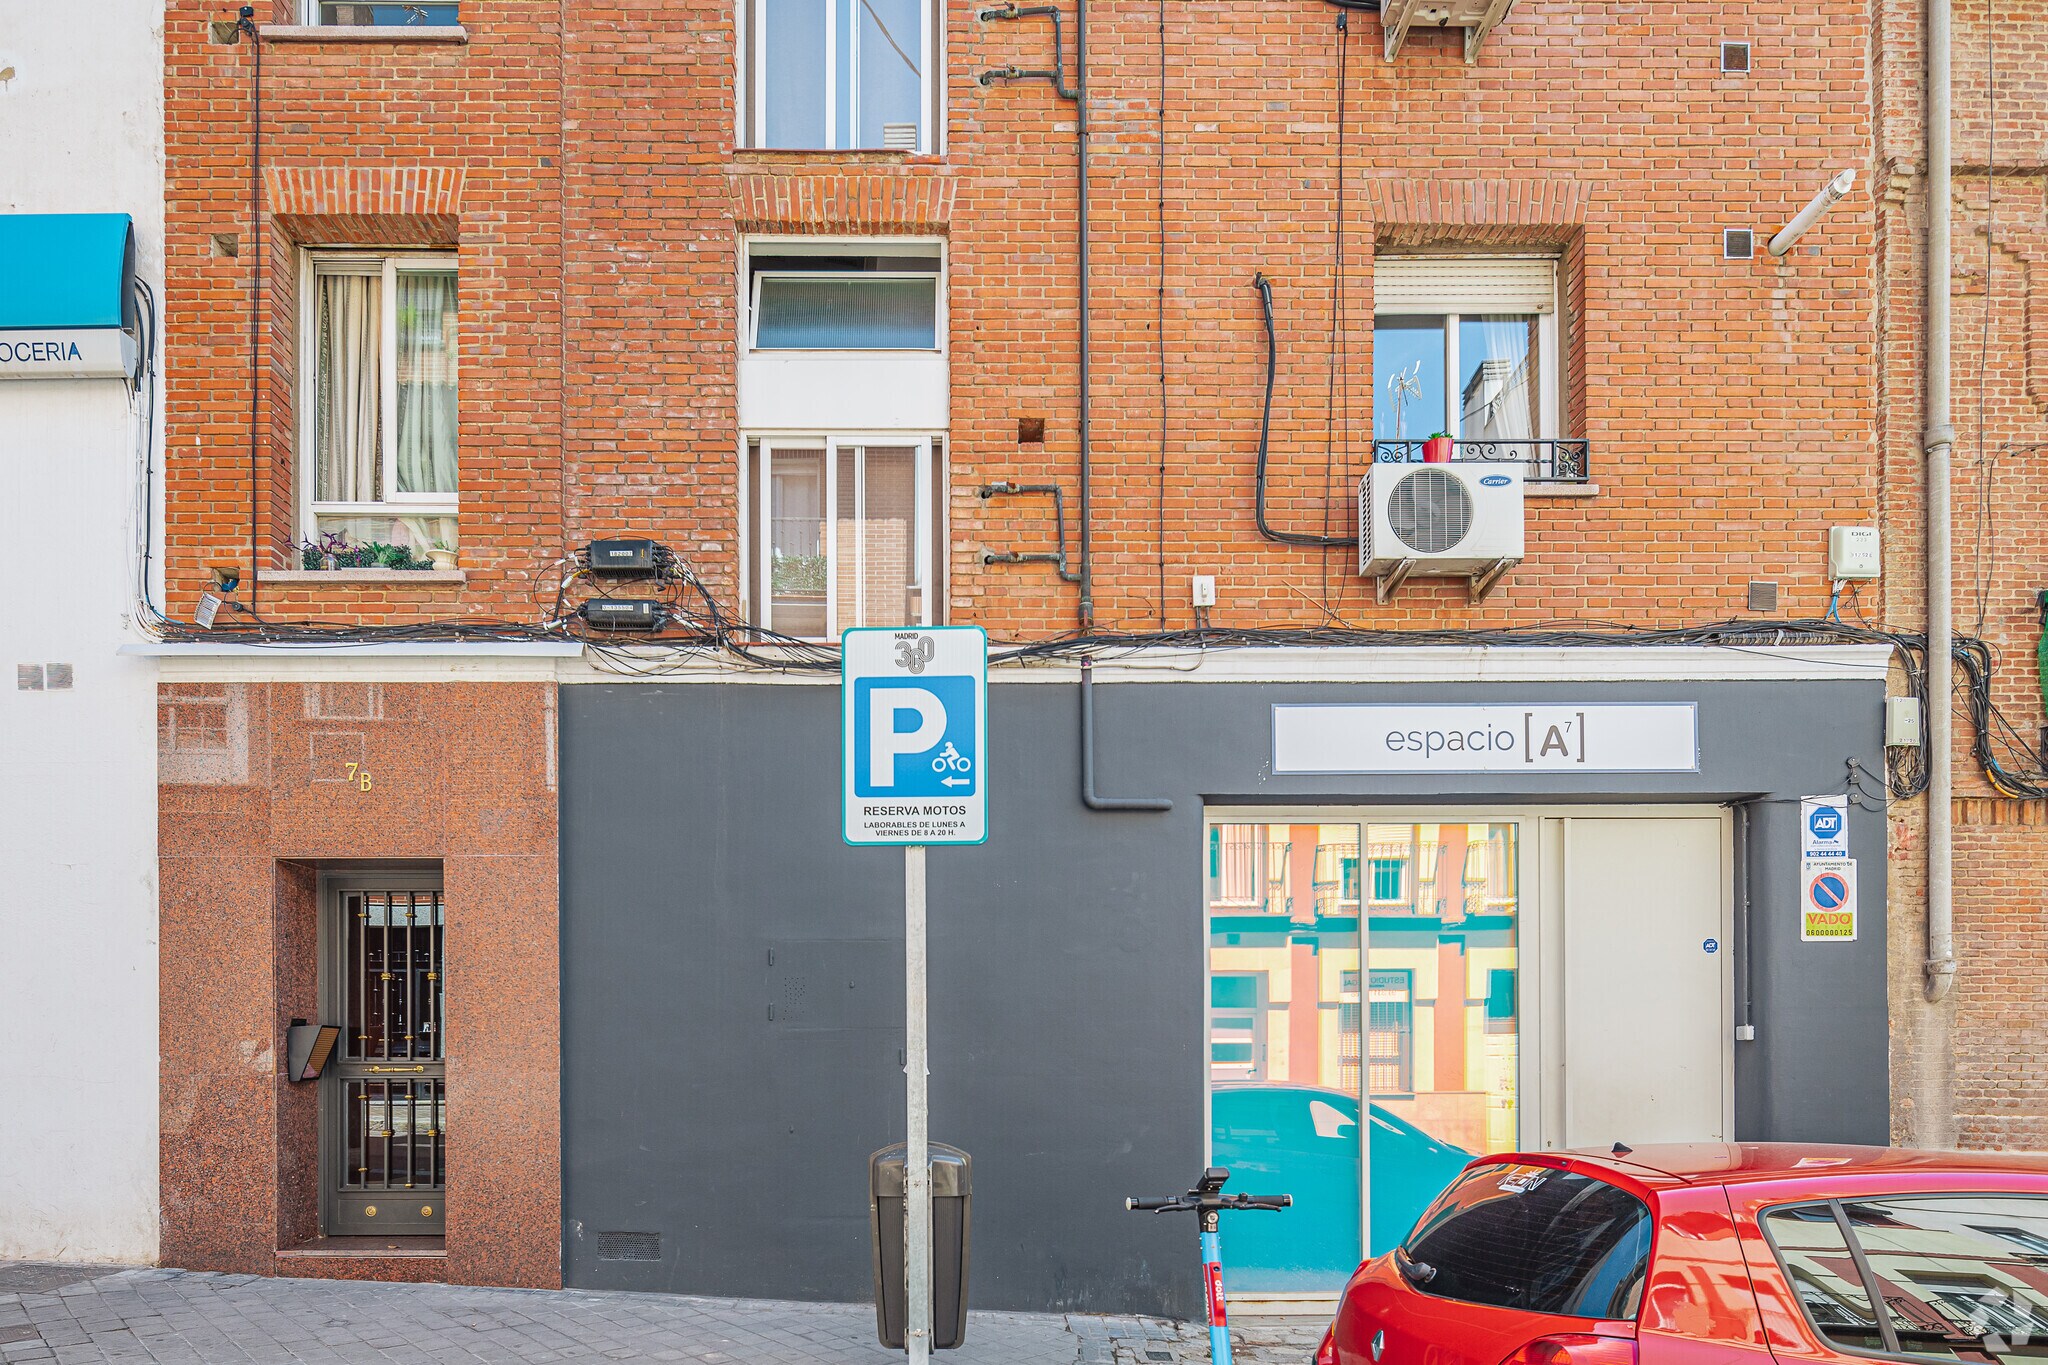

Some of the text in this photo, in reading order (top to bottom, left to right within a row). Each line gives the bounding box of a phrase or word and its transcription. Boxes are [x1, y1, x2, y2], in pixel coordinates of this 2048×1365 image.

[894, 632, 918, 640] MADRID
[869, 687, 948, 788] P
[1386, 723, 1515, 759] espacio
[863, 805, 966, 816] RESERVA MOTOS
[864, 821, 917, 829] LABORABLES
[1815, 817, 1837, 829] ADT
[1807, 913, 1852, 925] VADO
[1214, 1280, 1225, 1302] dott
